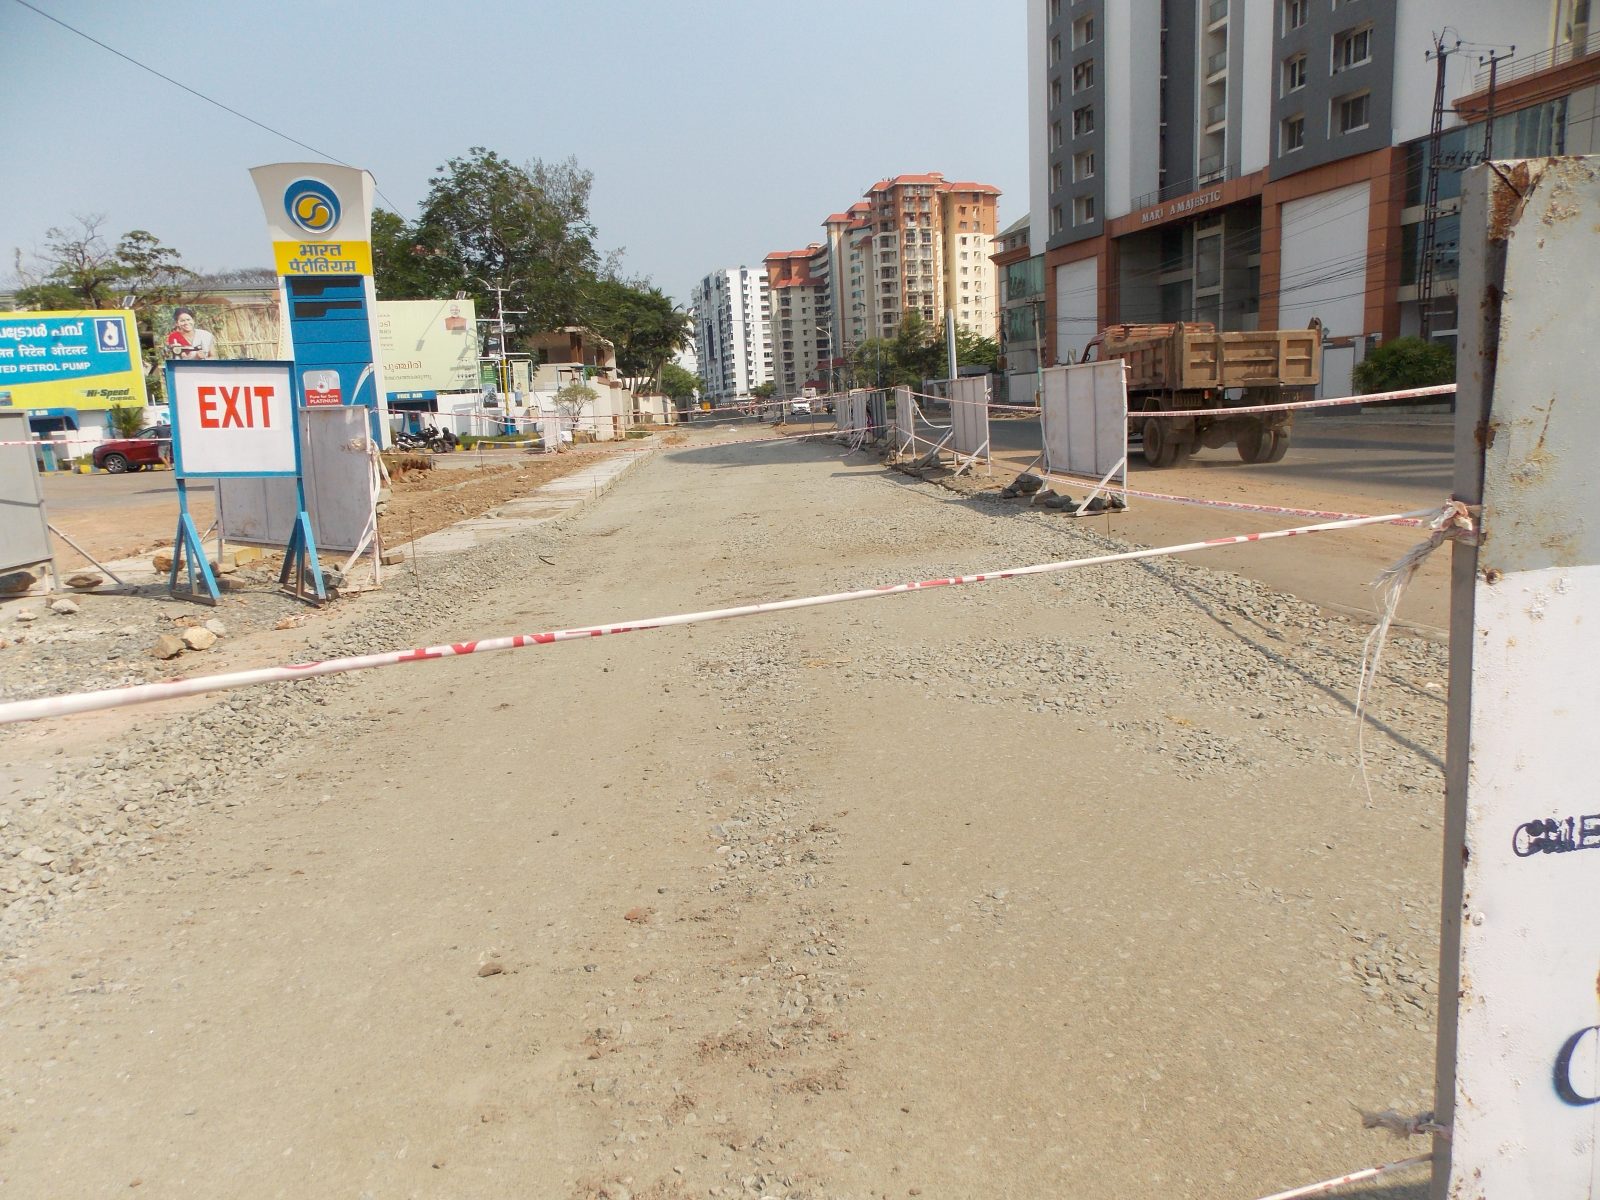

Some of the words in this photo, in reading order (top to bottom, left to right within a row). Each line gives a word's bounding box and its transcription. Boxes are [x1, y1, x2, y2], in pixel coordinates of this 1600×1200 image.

[299, 244, 341, 256] भारत
[289, 257, 356, 275] पेट्रोलियम
[19, 363, 61, 373] PETROL
[62, 361, 91, 371] PUMP
[197, 386, 275, 429] EXIT
